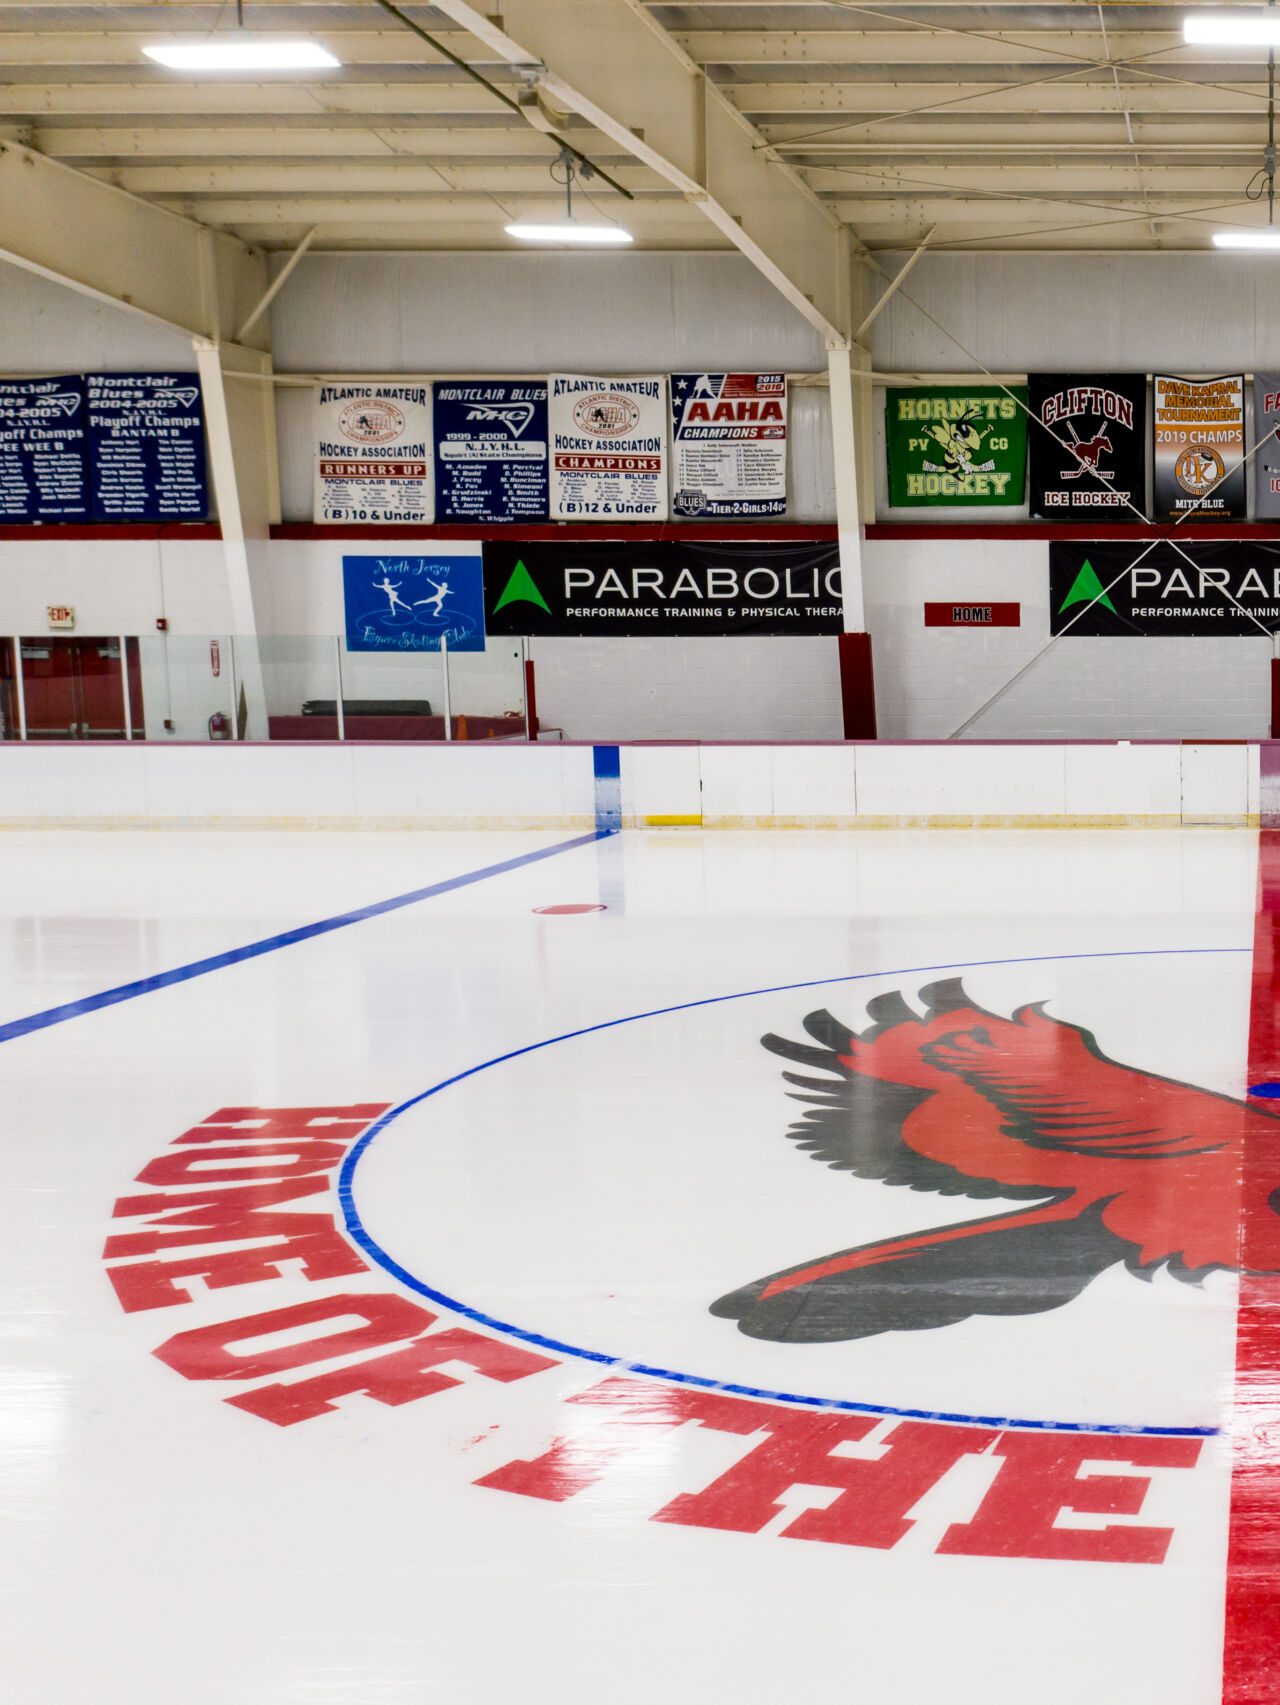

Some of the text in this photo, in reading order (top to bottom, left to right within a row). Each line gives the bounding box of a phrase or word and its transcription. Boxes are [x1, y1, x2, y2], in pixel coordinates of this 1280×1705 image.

[0, 382, 61, 394] ntclair
[88, 376, 177, 387] Montclair
[88, 388, 144, 398] Blues
[438, 389, 548, 400] MONTCLAIR BLUES
[554, 380, 659, 400] ATLANTIC AMATEUR
[1158, 381, 1241, 397] DAVE KAPRAL
[320, 388, 426, 406] ATLANTIC AMATEUR
[1165, 394, 1234, 408] MEMORIAL
[89, 400, 177, 408] 2004-2005
[898, 399, 1016, 420] HORNETS
[1042, 387, 1133, 430] CLIFTON
[687, 402, 784, 422] AAHA
[1157, 408, 1241, 422] TOURNAMENT
[90, 416, 200, 429] Playoff Champs
[29, 430, 84, 440] Champs
[112, 429, 180, 437] BANTAM B
[684, 428, 758, 438] CHAMPIONS
[1157, 430, 1242, 443] 2019 CHAMPS
[23, 442, 65, 452] WEE B
[555, 434, 660, 452] HOCKEY ASSOCIATION
[909, 438, 929, 451] PV
[990, 438, 1009, 450] CG
[320, 442, 426, 458] HOCKEY ASSOCIATION
[325, 465, 422, 474] RUNNERS UP
[558, 458, 658, 470] CHAMPIONS
[907, 473, 1010, 496] HOCKEY
[680, 497, 704, 507] BLUES
[1045, 492, 1131, 506] ICE HOCKEY
[1201, 500, 1224, 508] BLUE
[603, 503, 612, 513] &
[616, 503, 657, 513] Under
[371, 510, 380, 520] &
[384, 510, 426, 520] Under
[373, 559, 450, 578] North Jersey
[51, 608, 68, 621] EXIT
[566, 607, 844, 617] PERFORMANCE TRAINING & PHYSICAL THERA
[952, 607, 992, 622] HOME
[1132, 607, 1224, 616] PERFORMANCE
[102, 1102, 394, 1314] HOME
[150, 1293, 562, 1427] OF
[470, 1375, 1205, 1565] THE
